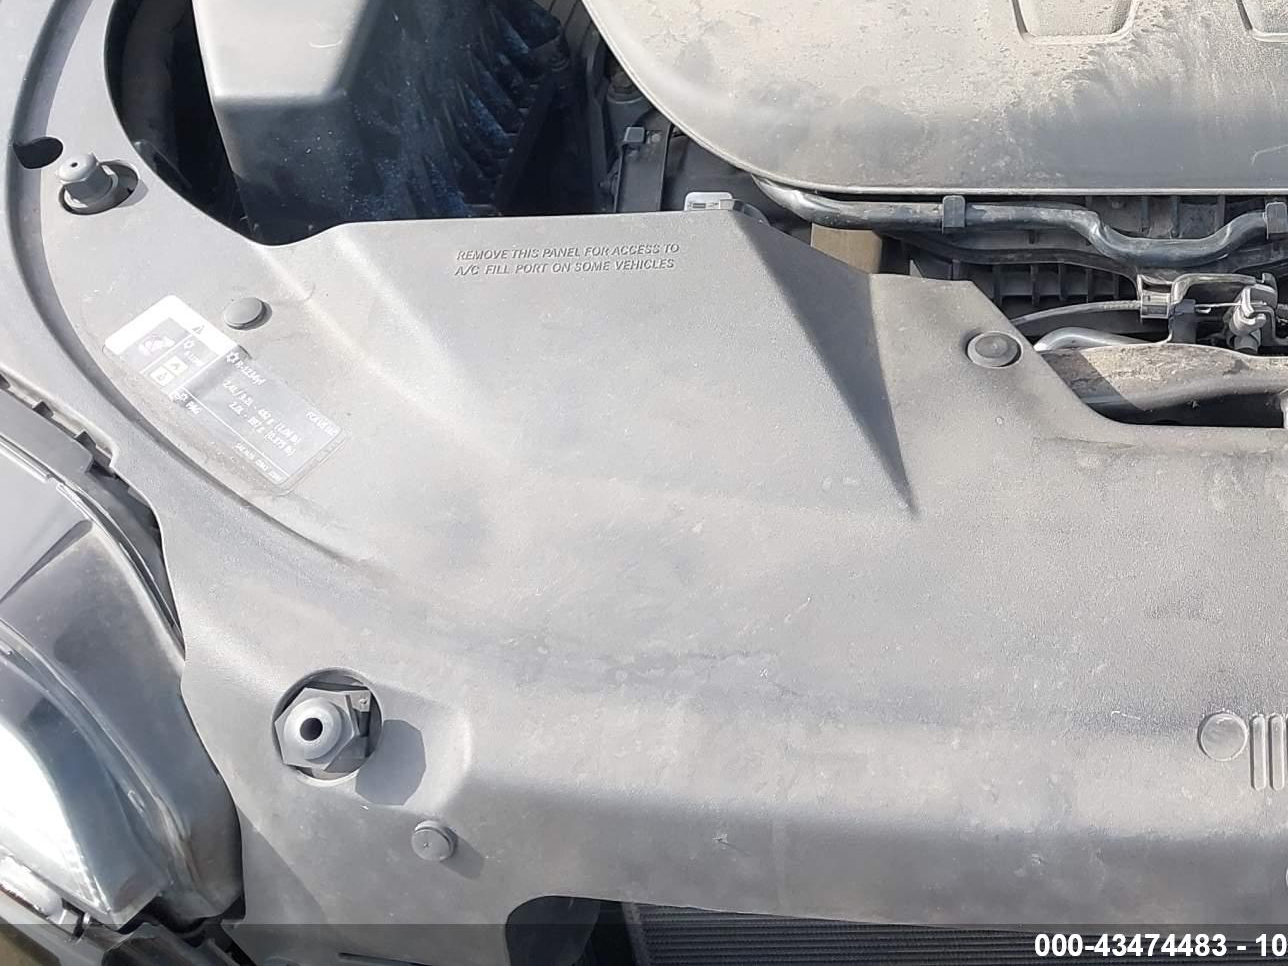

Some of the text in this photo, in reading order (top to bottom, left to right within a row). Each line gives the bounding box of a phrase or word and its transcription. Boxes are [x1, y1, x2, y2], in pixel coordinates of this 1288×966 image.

[456, 243, 680, 260] REMOVE THIS PANEL FOR ACCESS TO
[455, 259, 674, 276] A/C FILL PORT ON SOME VEHICLES
